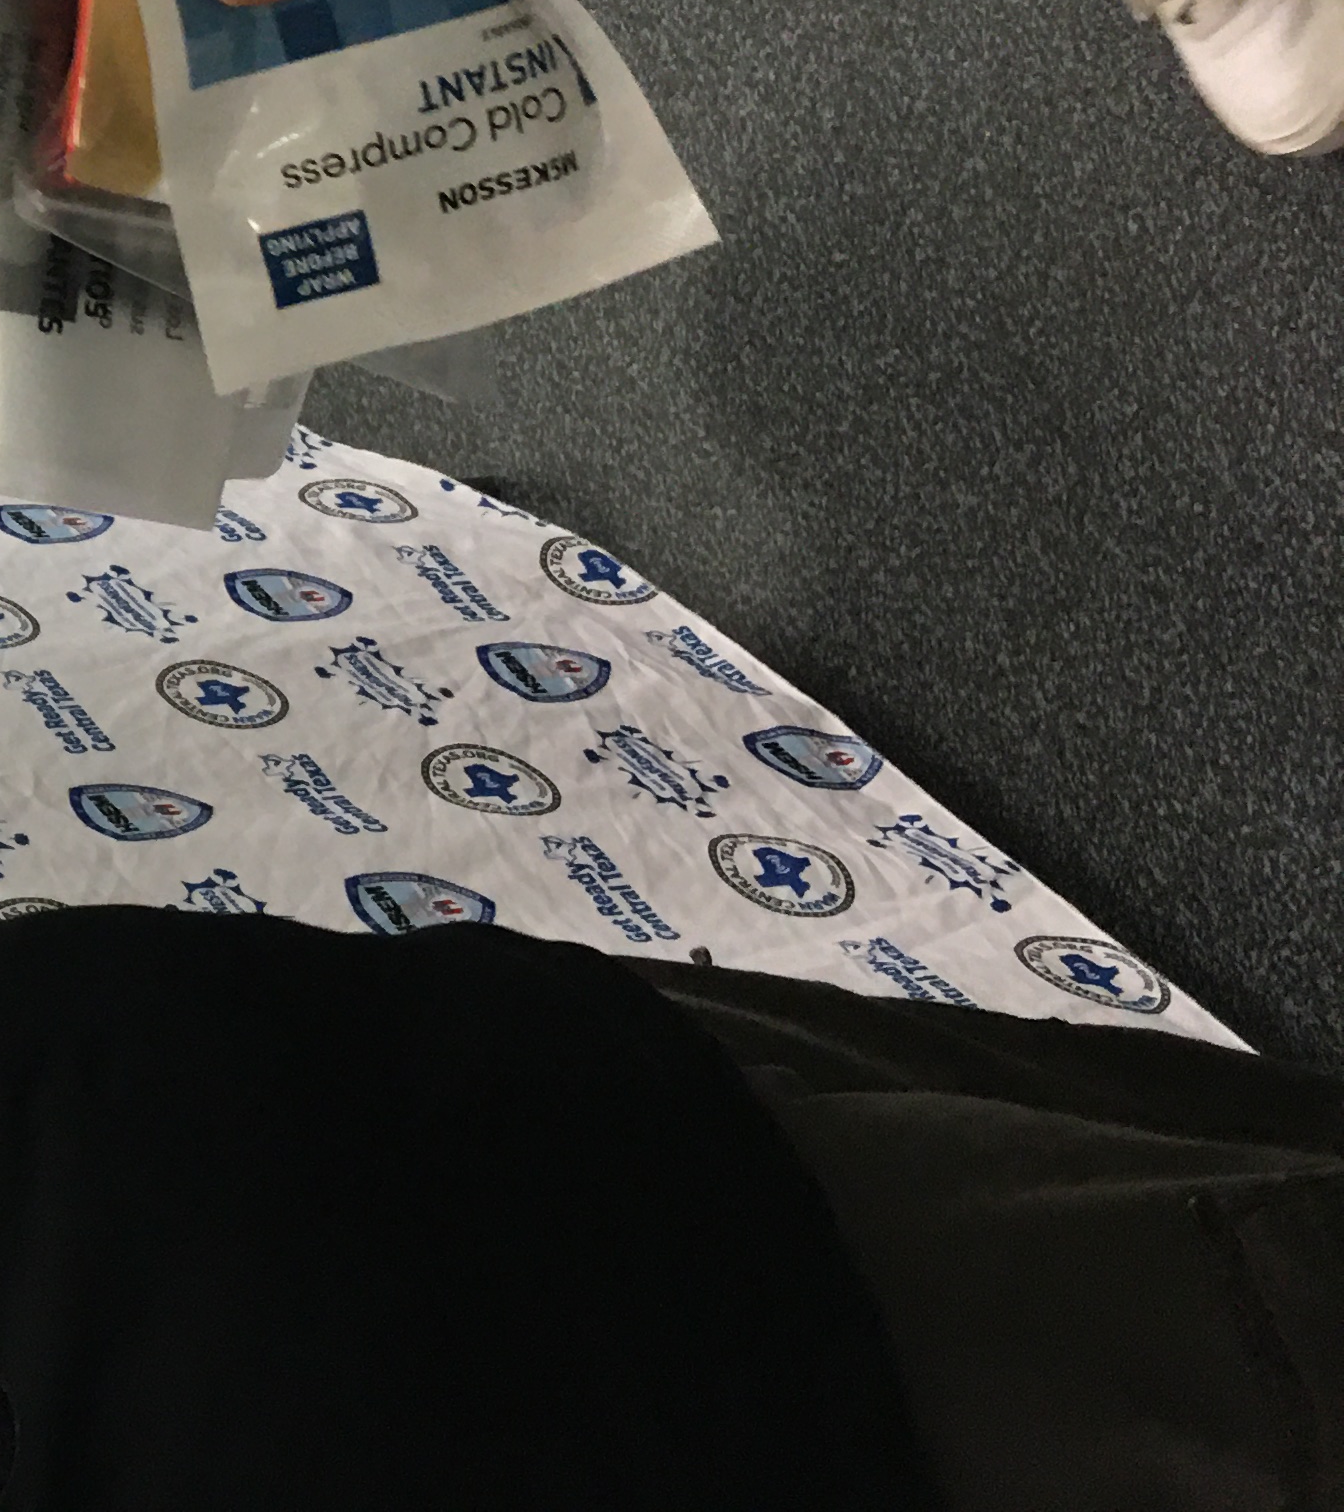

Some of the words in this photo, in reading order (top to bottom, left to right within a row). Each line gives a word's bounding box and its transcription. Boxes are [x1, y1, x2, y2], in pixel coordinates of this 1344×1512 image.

[417, 39, 559, 115] INSTANT
[483, 86, 568, 143] Cold
[279, 115, 477, 190] Compress
[264, 216, 363, 258] APPLYING
[279, 242, 361, 280] BEFORE
[295, 268, 358, 298] WRAP
[671, 625, 720, 663] Texas
[32, 668, 77, 704] Texas
[493, 650, 548, 694] HSEM
[21, 690, 69, 730] Ready
[65, 704, 117, 752] Central
[55, 731, 89, 755] Get
[761, 741, 823, 781] HSEM
[291, 753, 337, 795] Texas
[86, 793, 140, 834] HSEM
[280, 776, 333, 818] Ready
[324, 794, 389, 833] Central
[328, 815, 362, 836] Get
[573, 834, 618, 881] Texas
[566, 862, 617, 916] Ready
[611, 877, 682, 941] Central
[620, 916, 654, 943] Get
[872, 935, 929, 976] Texas
[867, 960, 937, 1001] Ready
[913, 973, 979, 1008] ntral
